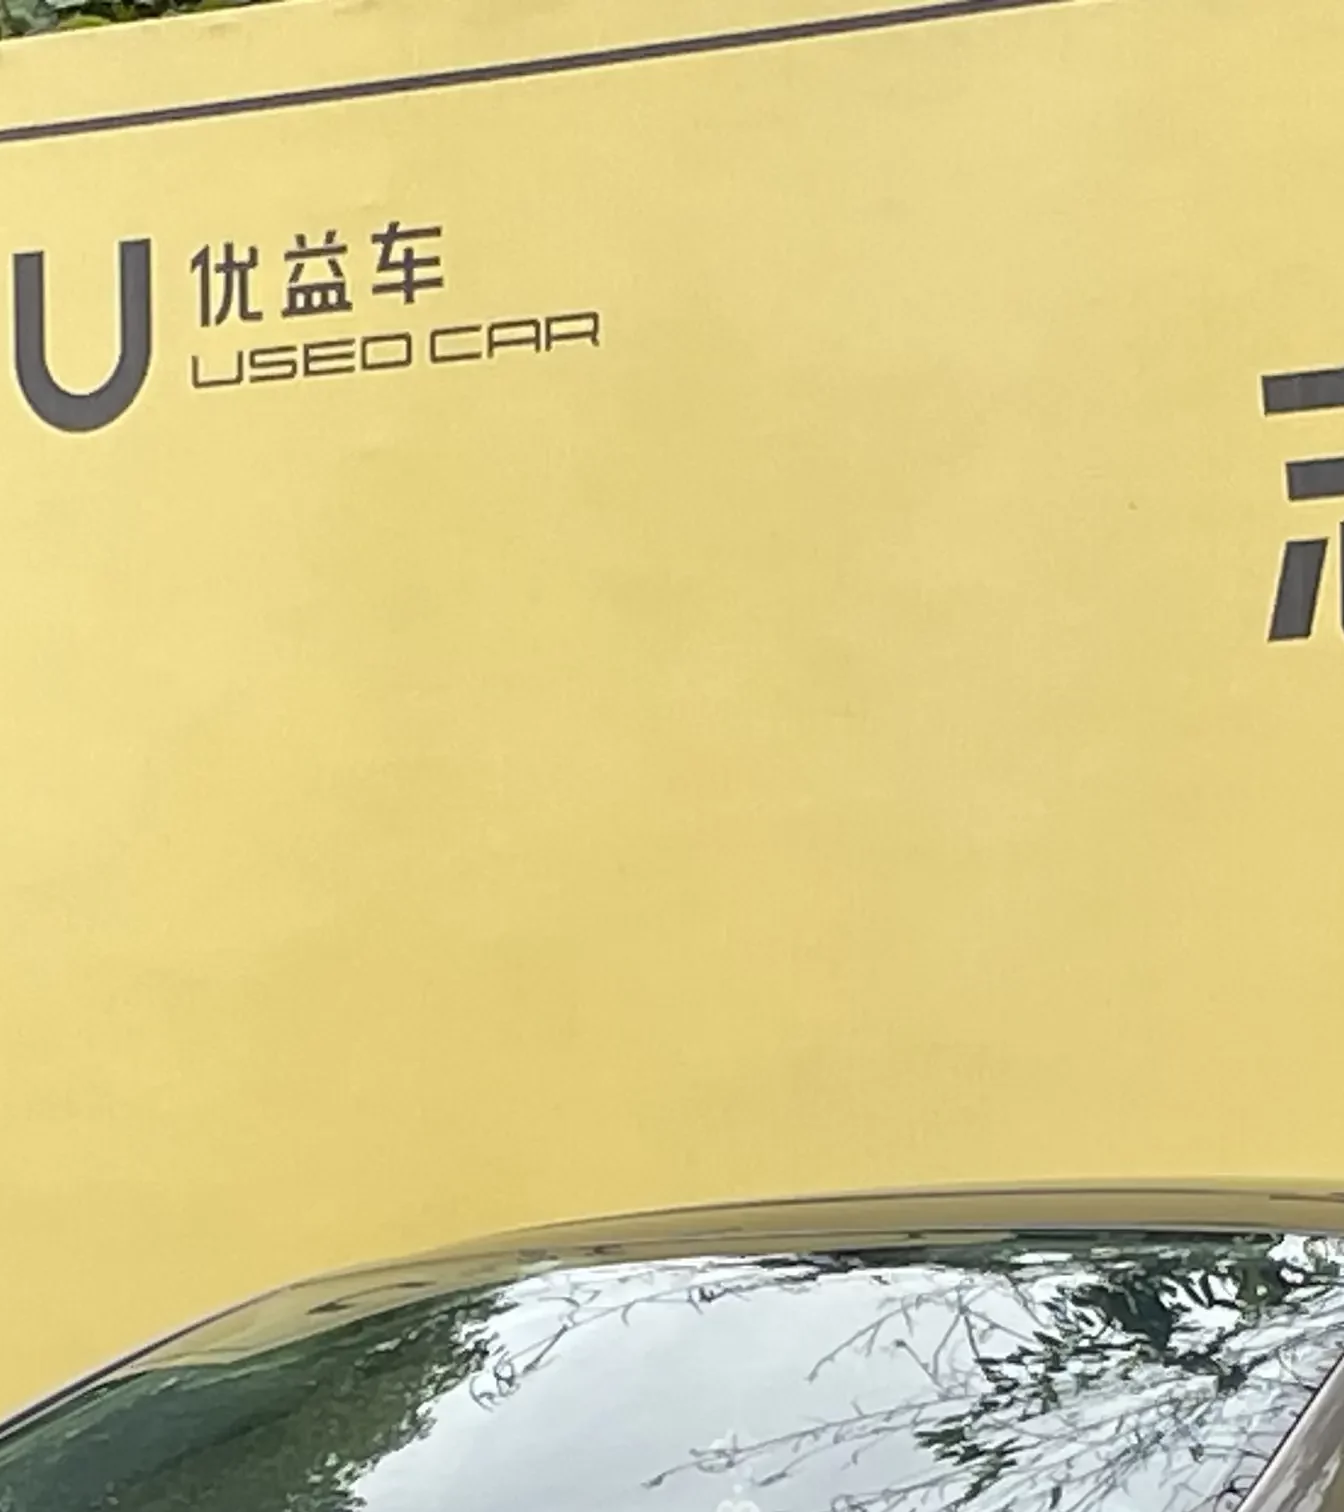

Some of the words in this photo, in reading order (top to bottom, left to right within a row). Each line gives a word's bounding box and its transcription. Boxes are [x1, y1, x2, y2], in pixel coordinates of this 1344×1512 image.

[190, 221, 444, 327] 优益车
[13, 238, 152, 433] U
[191, 332, 413, 389] USED
[429, 311, 599, 364] CAR
